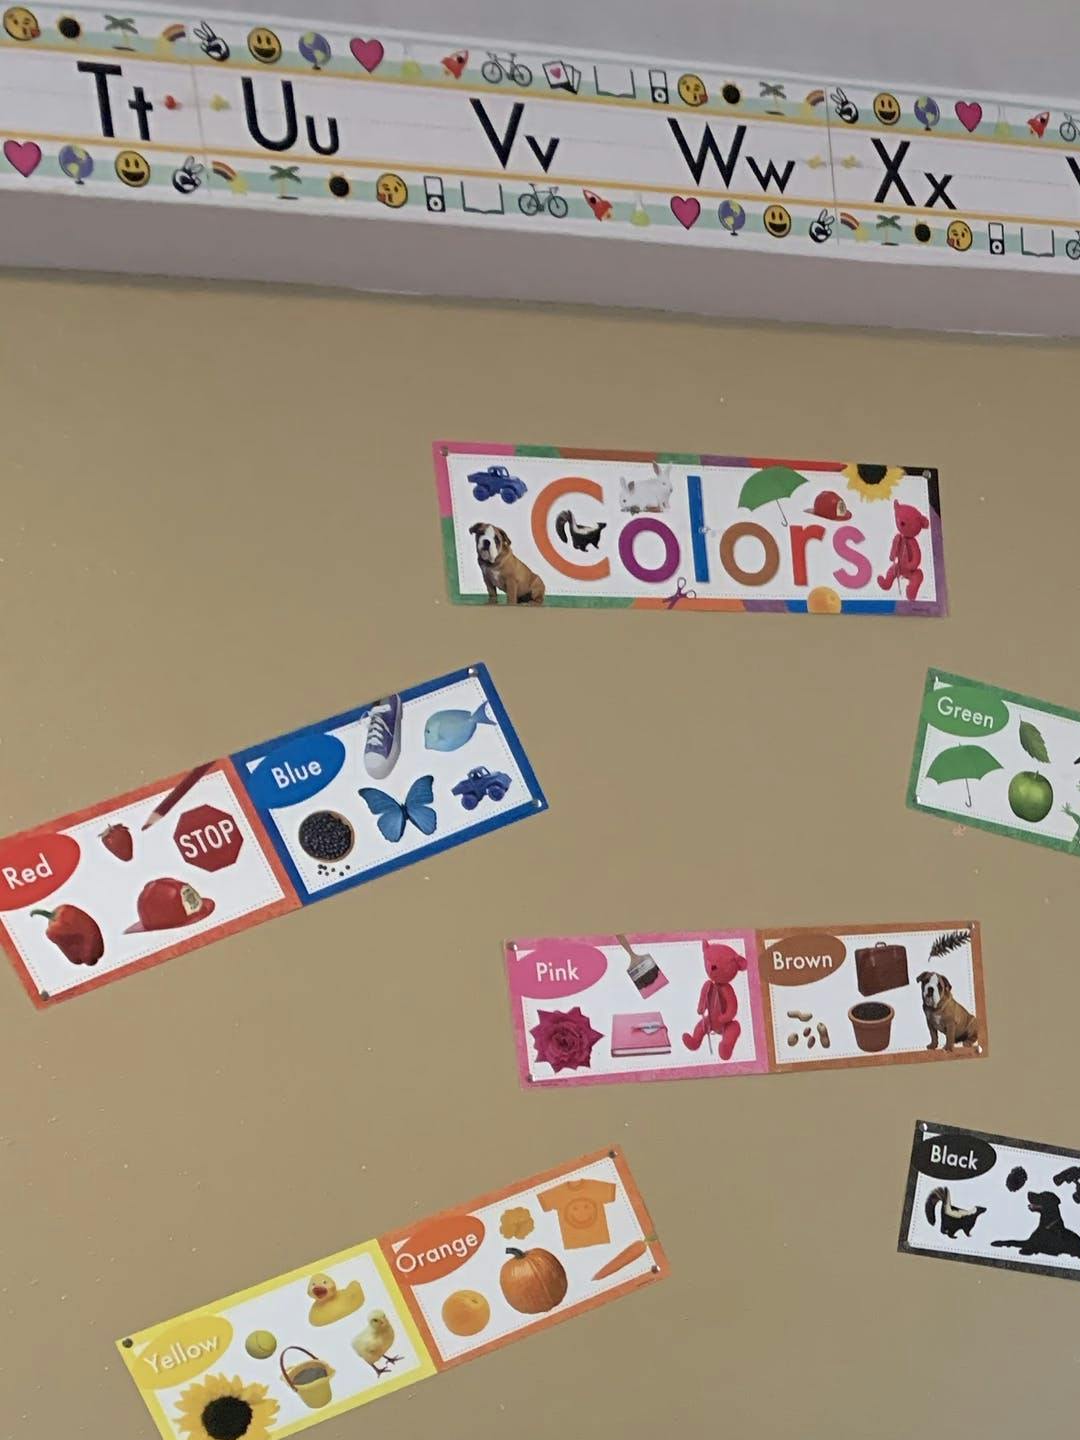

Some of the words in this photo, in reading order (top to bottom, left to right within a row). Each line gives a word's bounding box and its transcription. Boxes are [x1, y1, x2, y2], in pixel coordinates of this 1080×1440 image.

[77, 60, 154, 142] Tt
[241, 77, 341, 155] Uu
[469, 98, 560, 173] Vv
[667, 117, 796, 194] Ww
[870, 137, 957, 210] Xx
[531, 474, 873, 590] Colors
[937, 696, 994, 728] Green
[271, 758, 322, 788] Blue
[179, 819, 235, 859] STOP
[2, 853, 53, 890] Red
[536, 962, 579, 982] Pink
[773, 951, 833, 971] Brown
[931, 1145, 978, 1171] Black
[396, 1230, 478, 1273] Orange
[143, 1333, 220, 1375] Yellow
